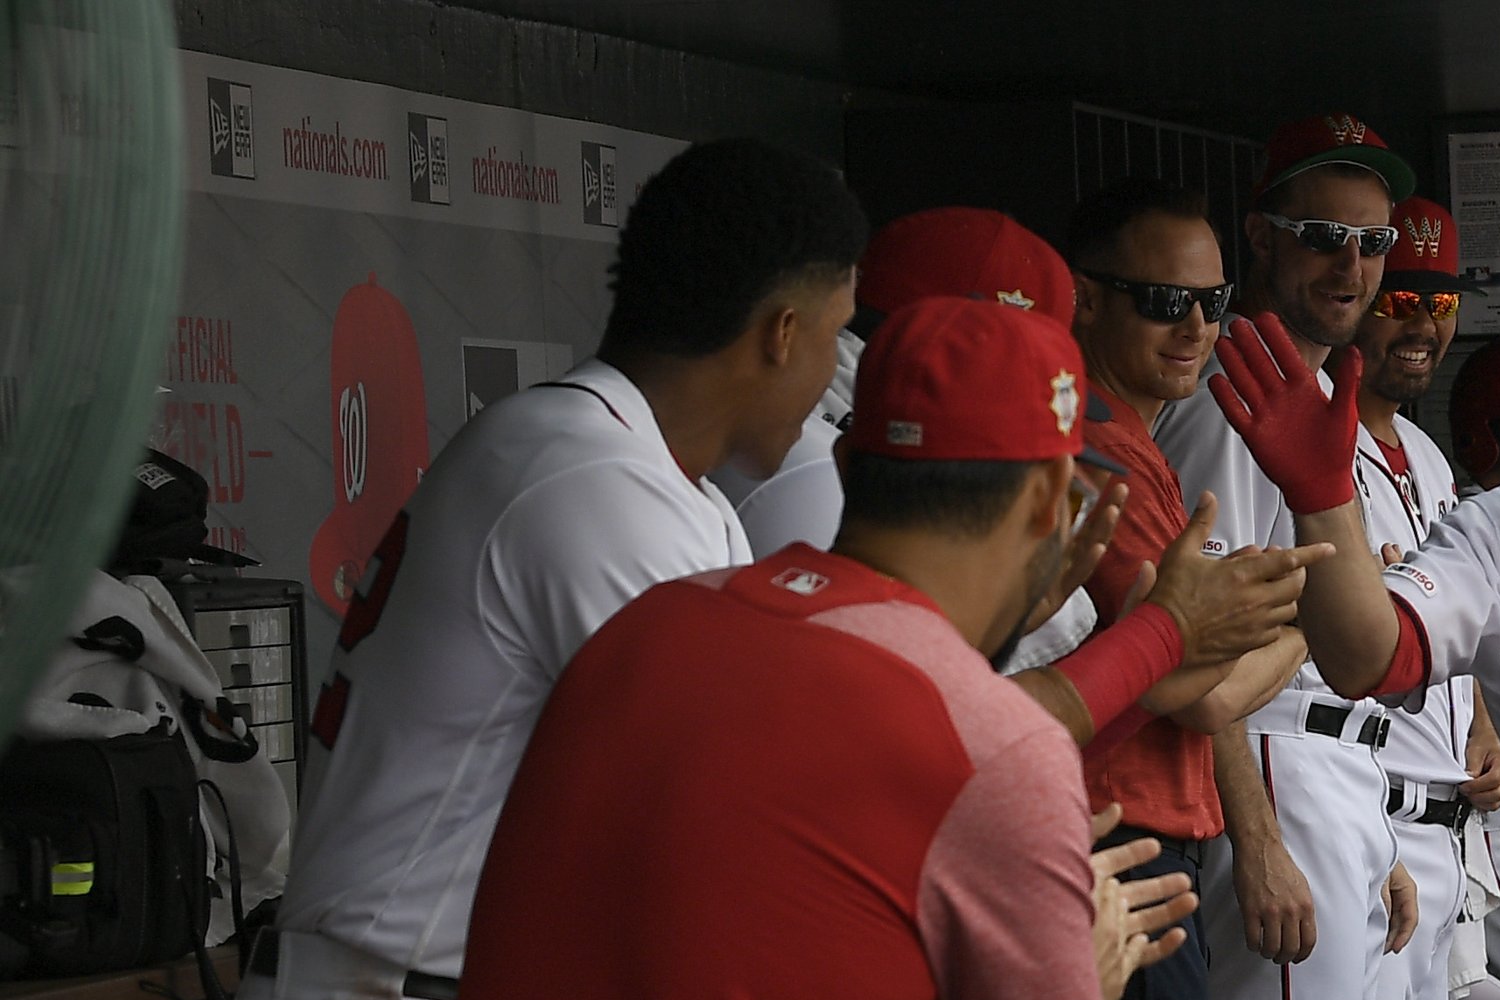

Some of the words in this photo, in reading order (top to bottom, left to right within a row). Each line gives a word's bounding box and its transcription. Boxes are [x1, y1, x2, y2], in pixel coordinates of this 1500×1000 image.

[233, 104, 251, 130] NEW
[234, 131, 252, 158] ERA
[282, 115, 388, 180] nationals.com
[430, 136, 446, 160] NEW
[431, 161, 447, 186] ERA
[472, 146, 560, 204] nationals.com
[602, 163, 615, 185] NEW
[603, 186, 616, 209] ERA
[1403, 216, 1442, 259] W
[165, 315, 238, 384] FICIAL
[1412, 571, 1435, 591] 150
